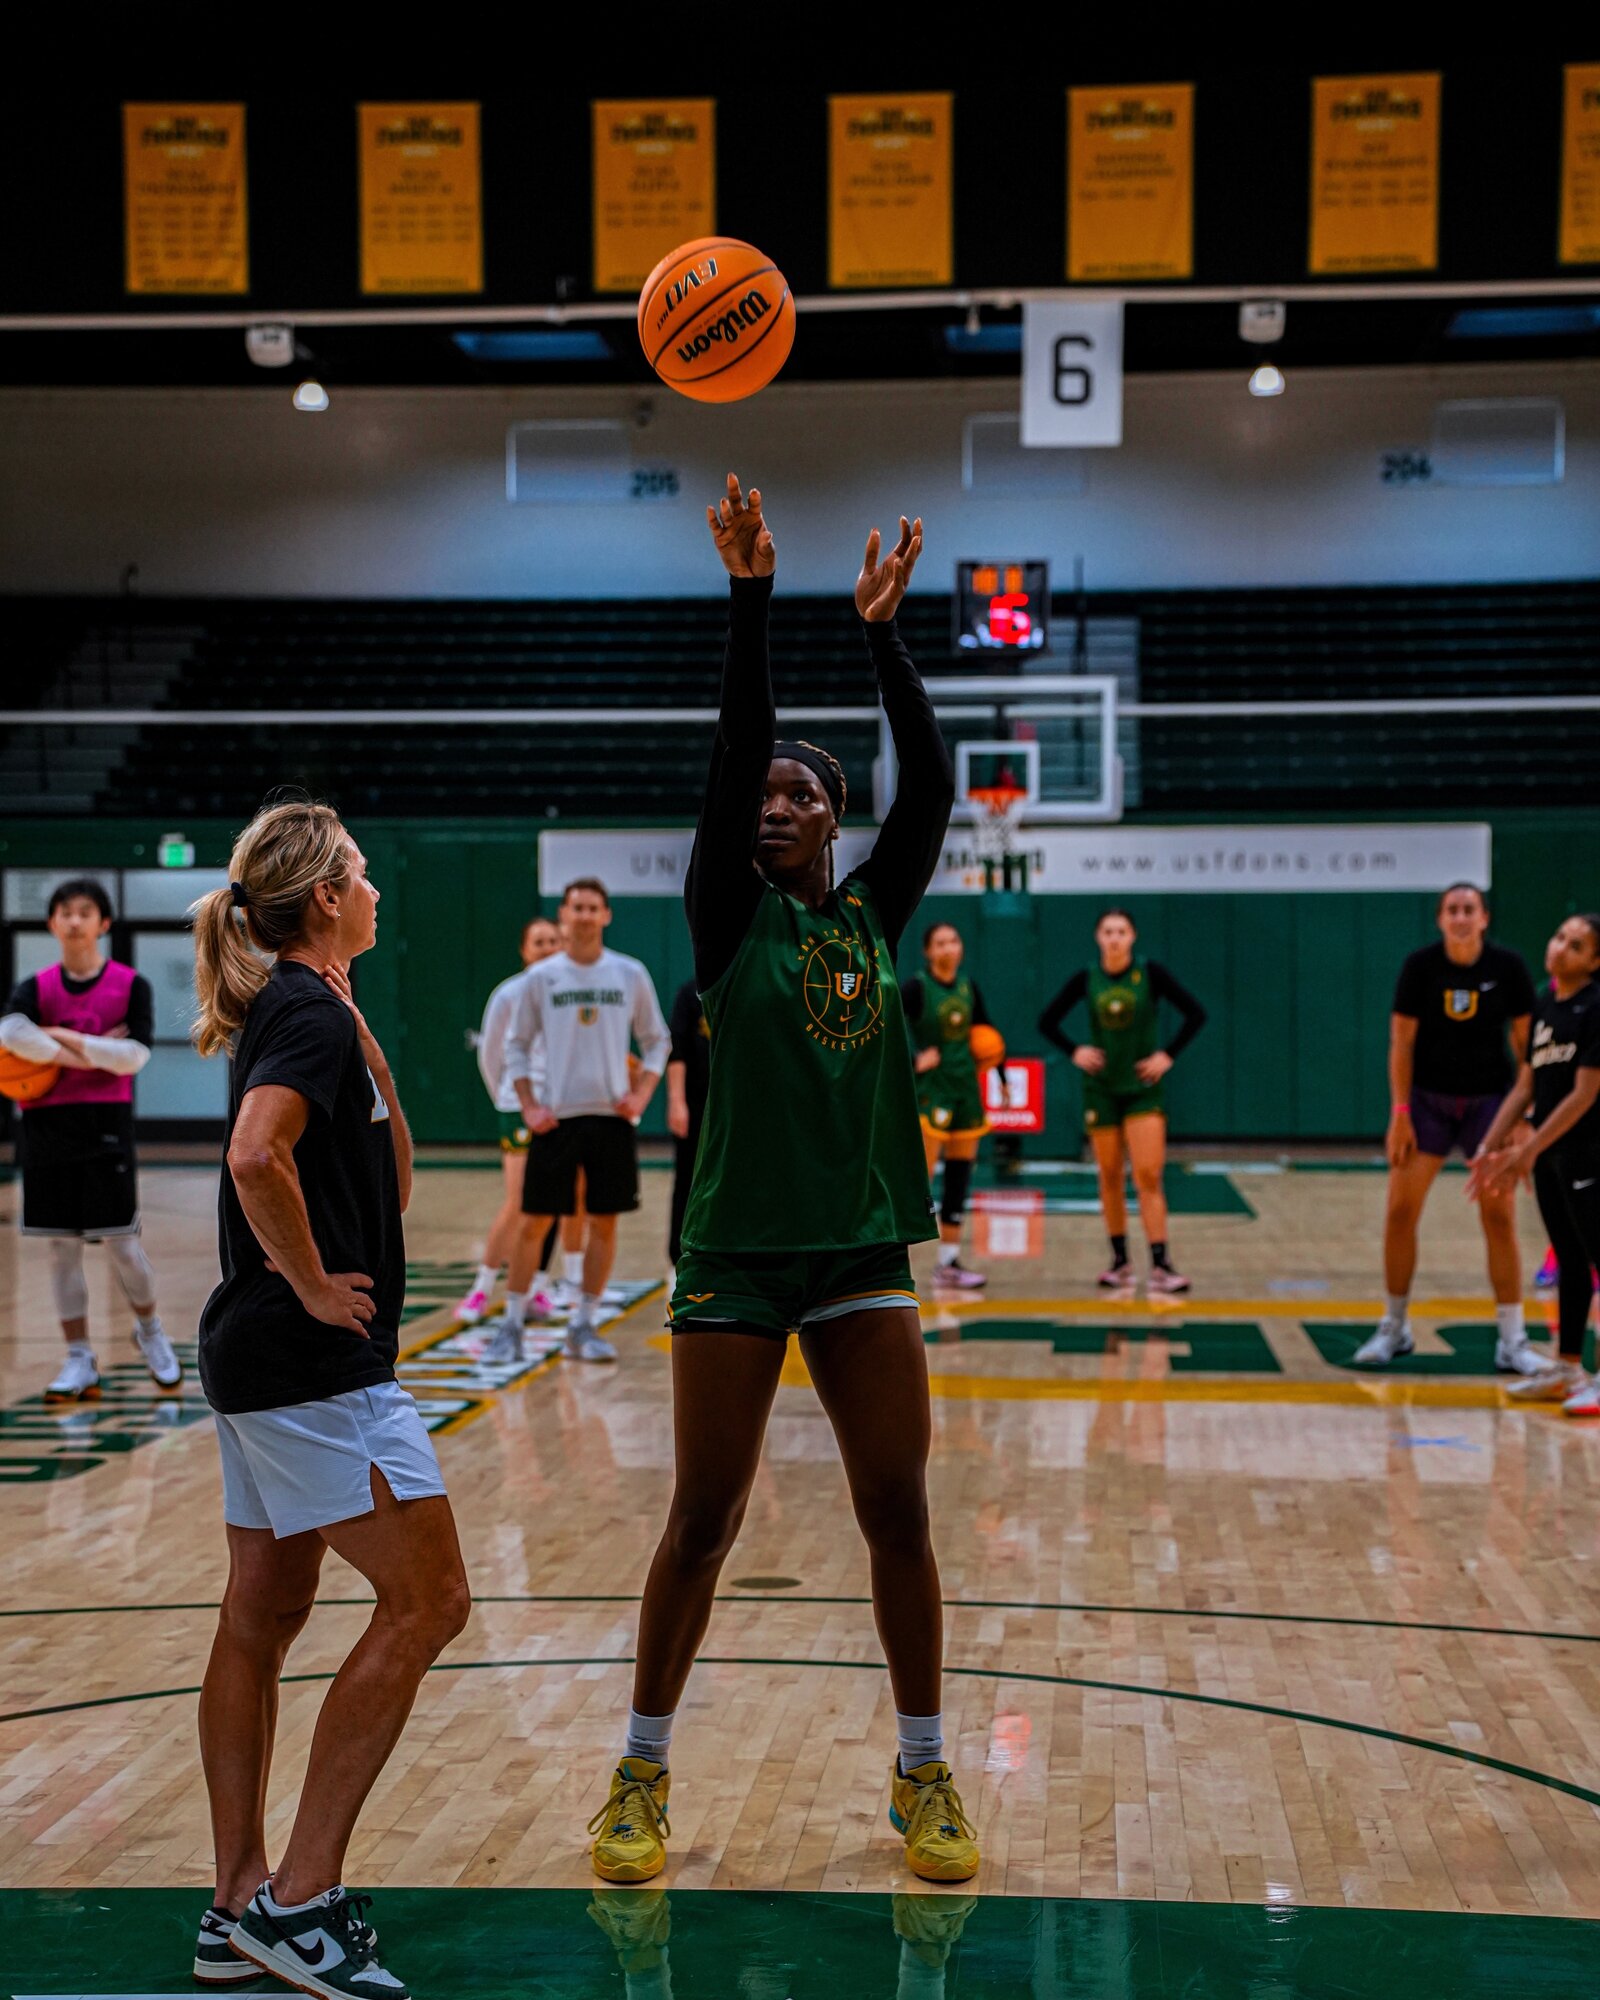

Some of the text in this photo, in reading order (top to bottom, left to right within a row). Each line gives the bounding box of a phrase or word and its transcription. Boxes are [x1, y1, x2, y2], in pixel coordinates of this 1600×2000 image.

[665, 257, 718, 312] EVO
[677, 290, 771, 362] Wilson
[1053, 334, 1092, 407] 6
[1081, 849, 1397, 875] www.usfdons.com
